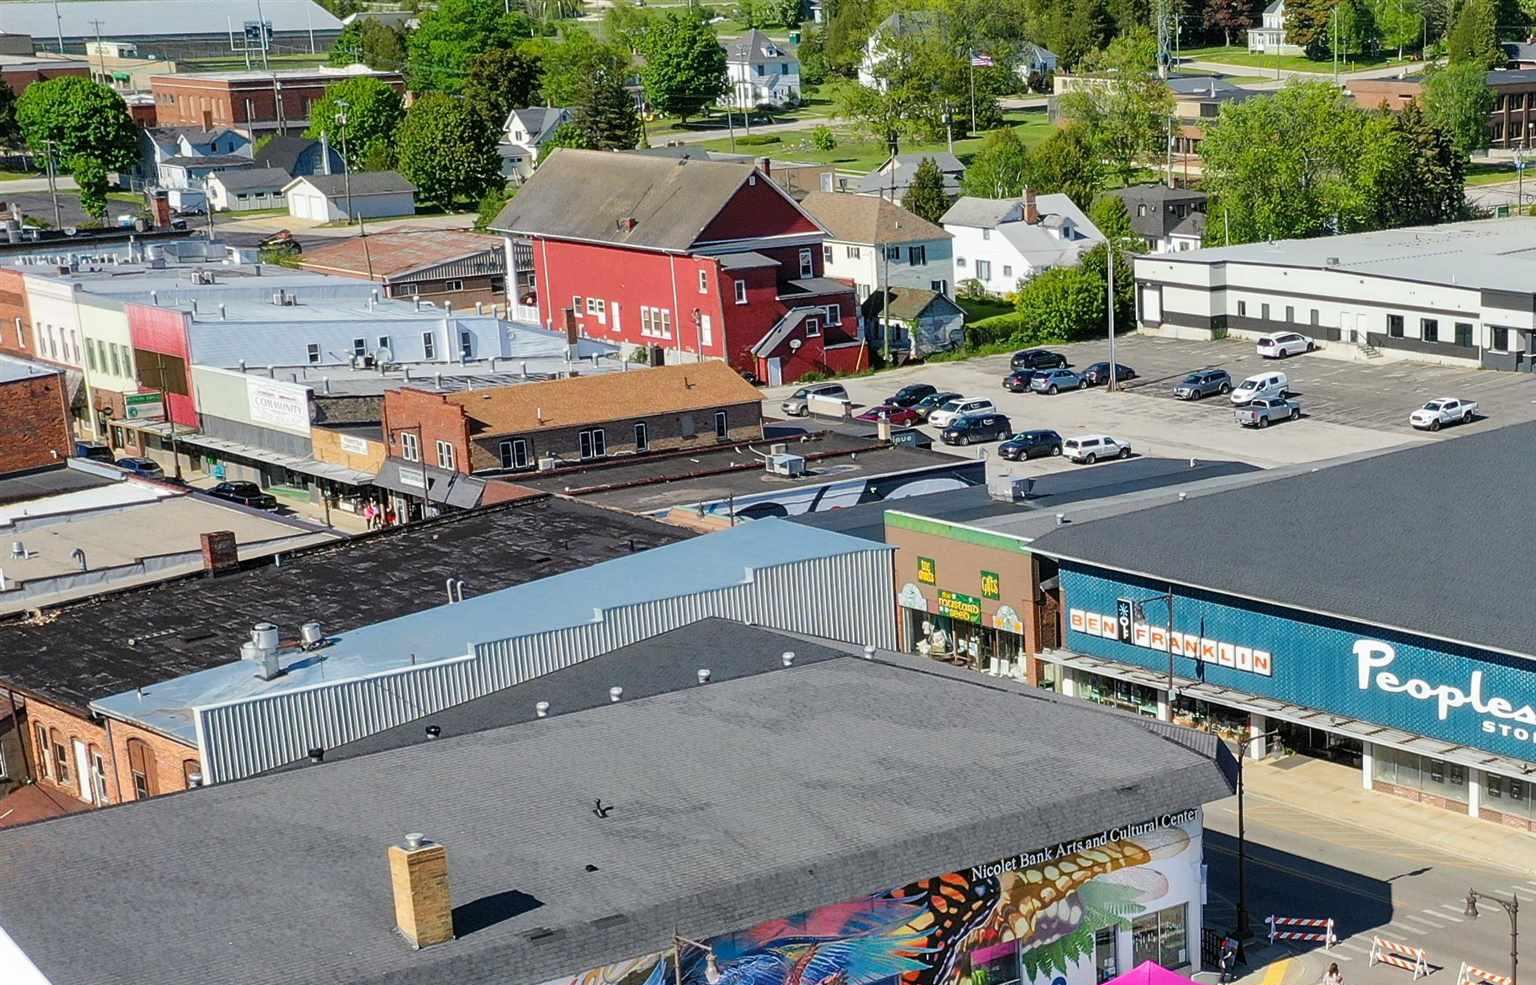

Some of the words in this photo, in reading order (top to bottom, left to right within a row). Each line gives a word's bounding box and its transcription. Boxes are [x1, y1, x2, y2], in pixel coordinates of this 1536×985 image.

[1072, 612, 1116, 634] BEN
[1136, 628, 1269, 670] FRANKLIN
[971, 859, 1018, 881] Nicolet
[1020, 850, 1054, 868] Bank
[1056, 840, 1084, 858] Arts
[1085, 832, 1107, 850] and
[1110, 817, 1159, 842] Cultural
[1161, 809, 1199, 828] Center
